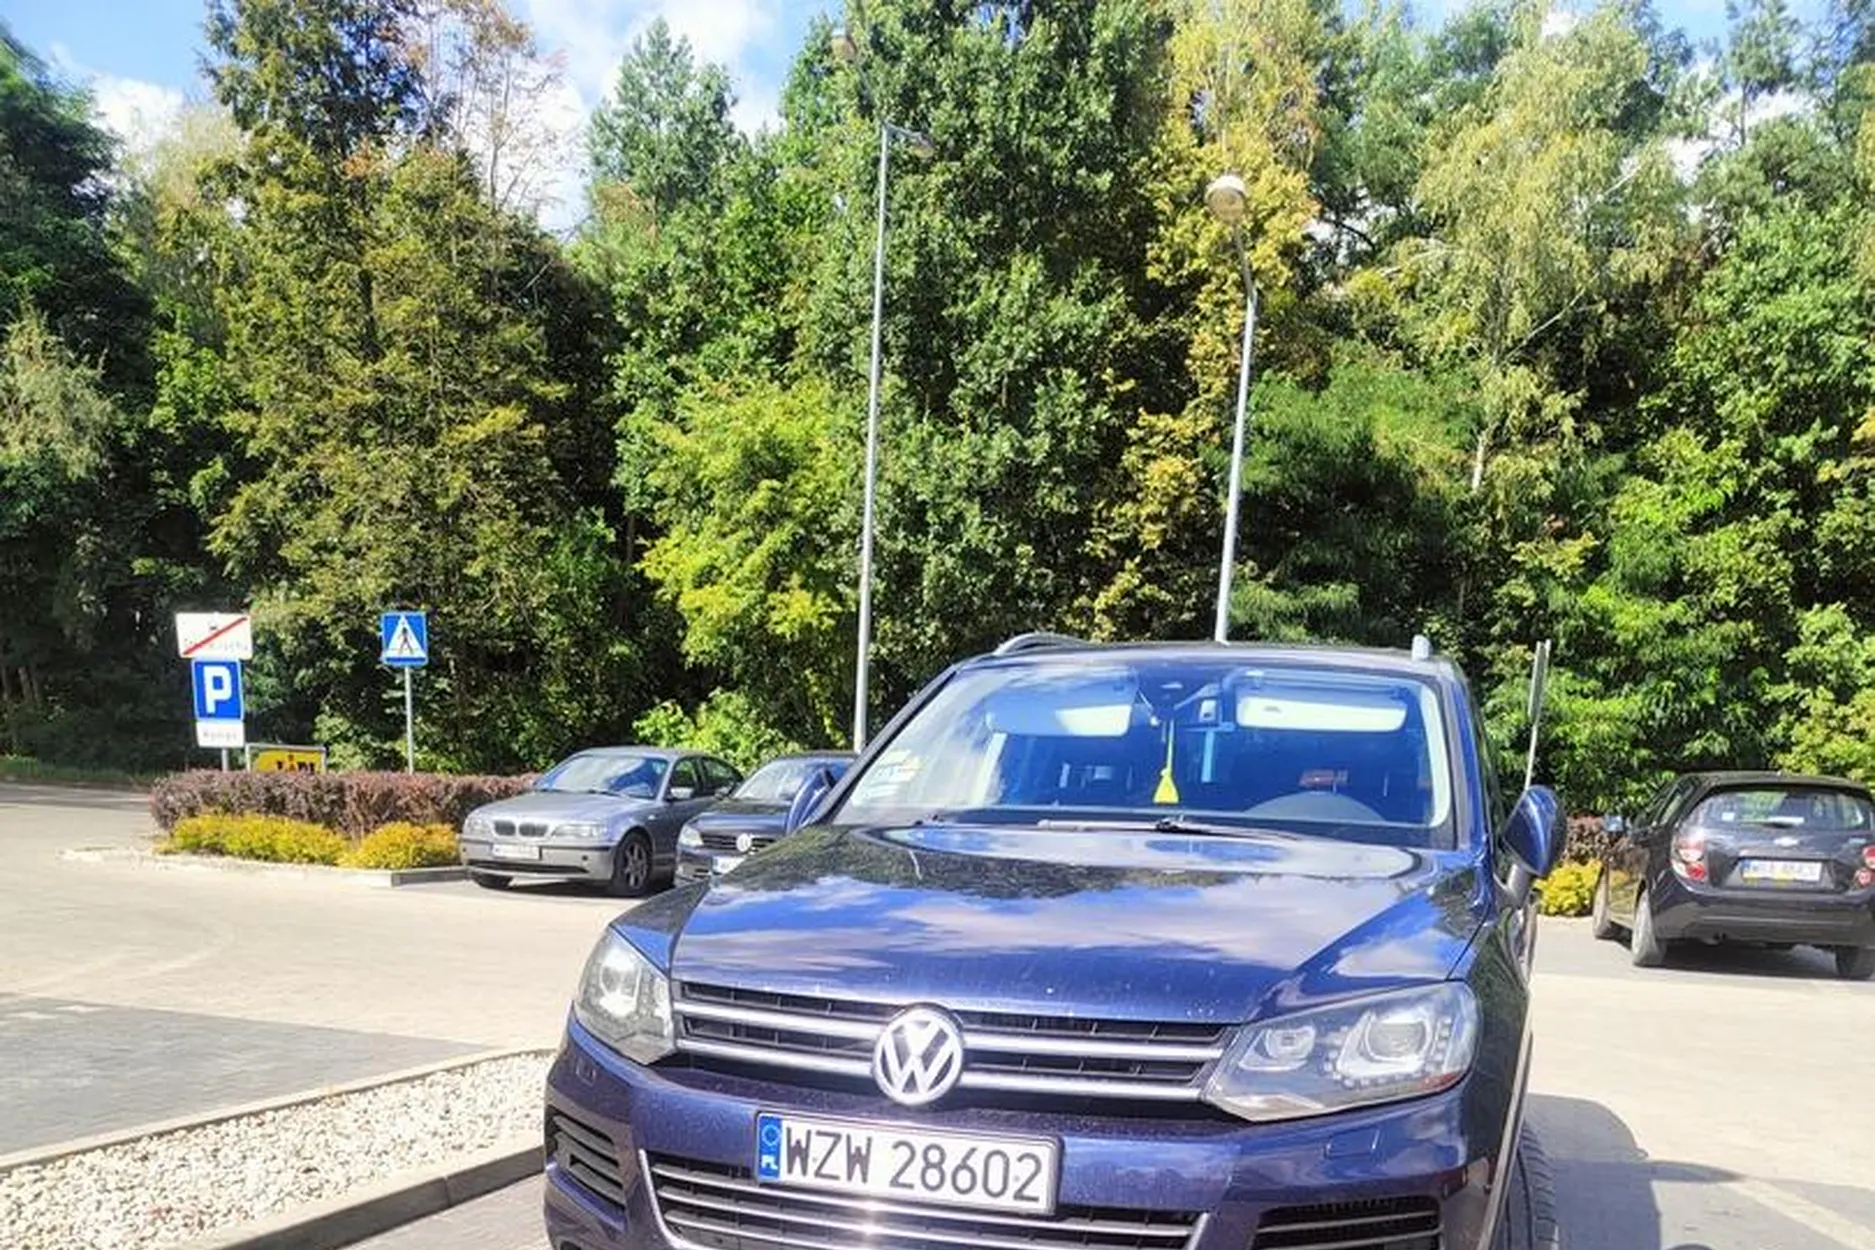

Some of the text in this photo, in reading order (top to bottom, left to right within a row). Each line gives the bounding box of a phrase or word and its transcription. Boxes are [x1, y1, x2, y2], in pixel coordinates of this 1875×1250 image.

[203, 665, 232, 714] P
[876, 1008, 962, 1105] VW
[761, 1154, 778, 1170] PL
[785, 1126, 1043, 1202] WZW 28602
